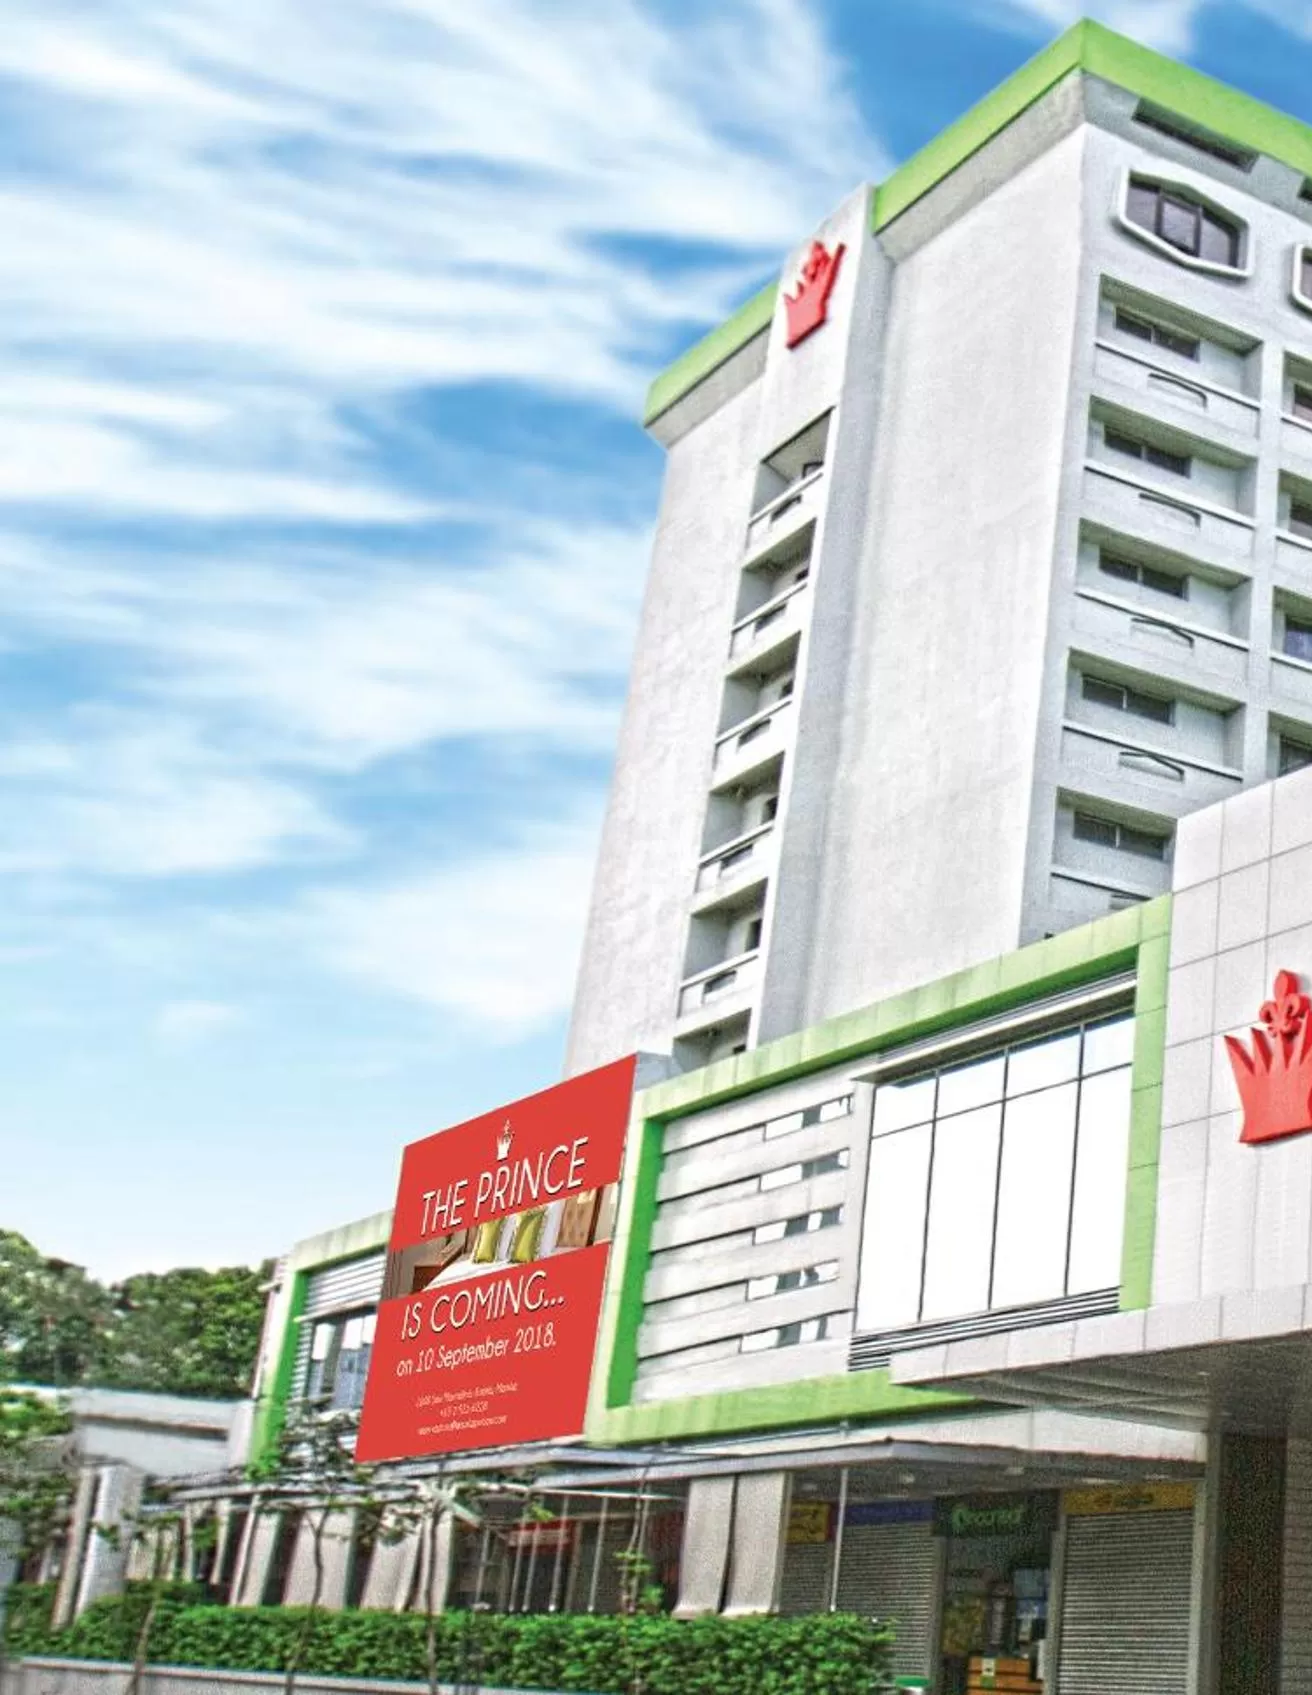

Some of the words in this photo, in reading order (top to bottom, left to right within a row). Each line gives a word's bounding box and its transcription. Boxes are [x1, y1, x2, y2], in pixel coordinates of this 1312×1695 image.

[420, 1179, 468, 1236] THE
[473, 1136, 589, 1218] PRINCE
[401, 1301, 423, 1341] IS
[396, 1358, 413, 1377] on
[416, 1347, 435, 1373] 10
[437, 1336, 510, 1371] September
